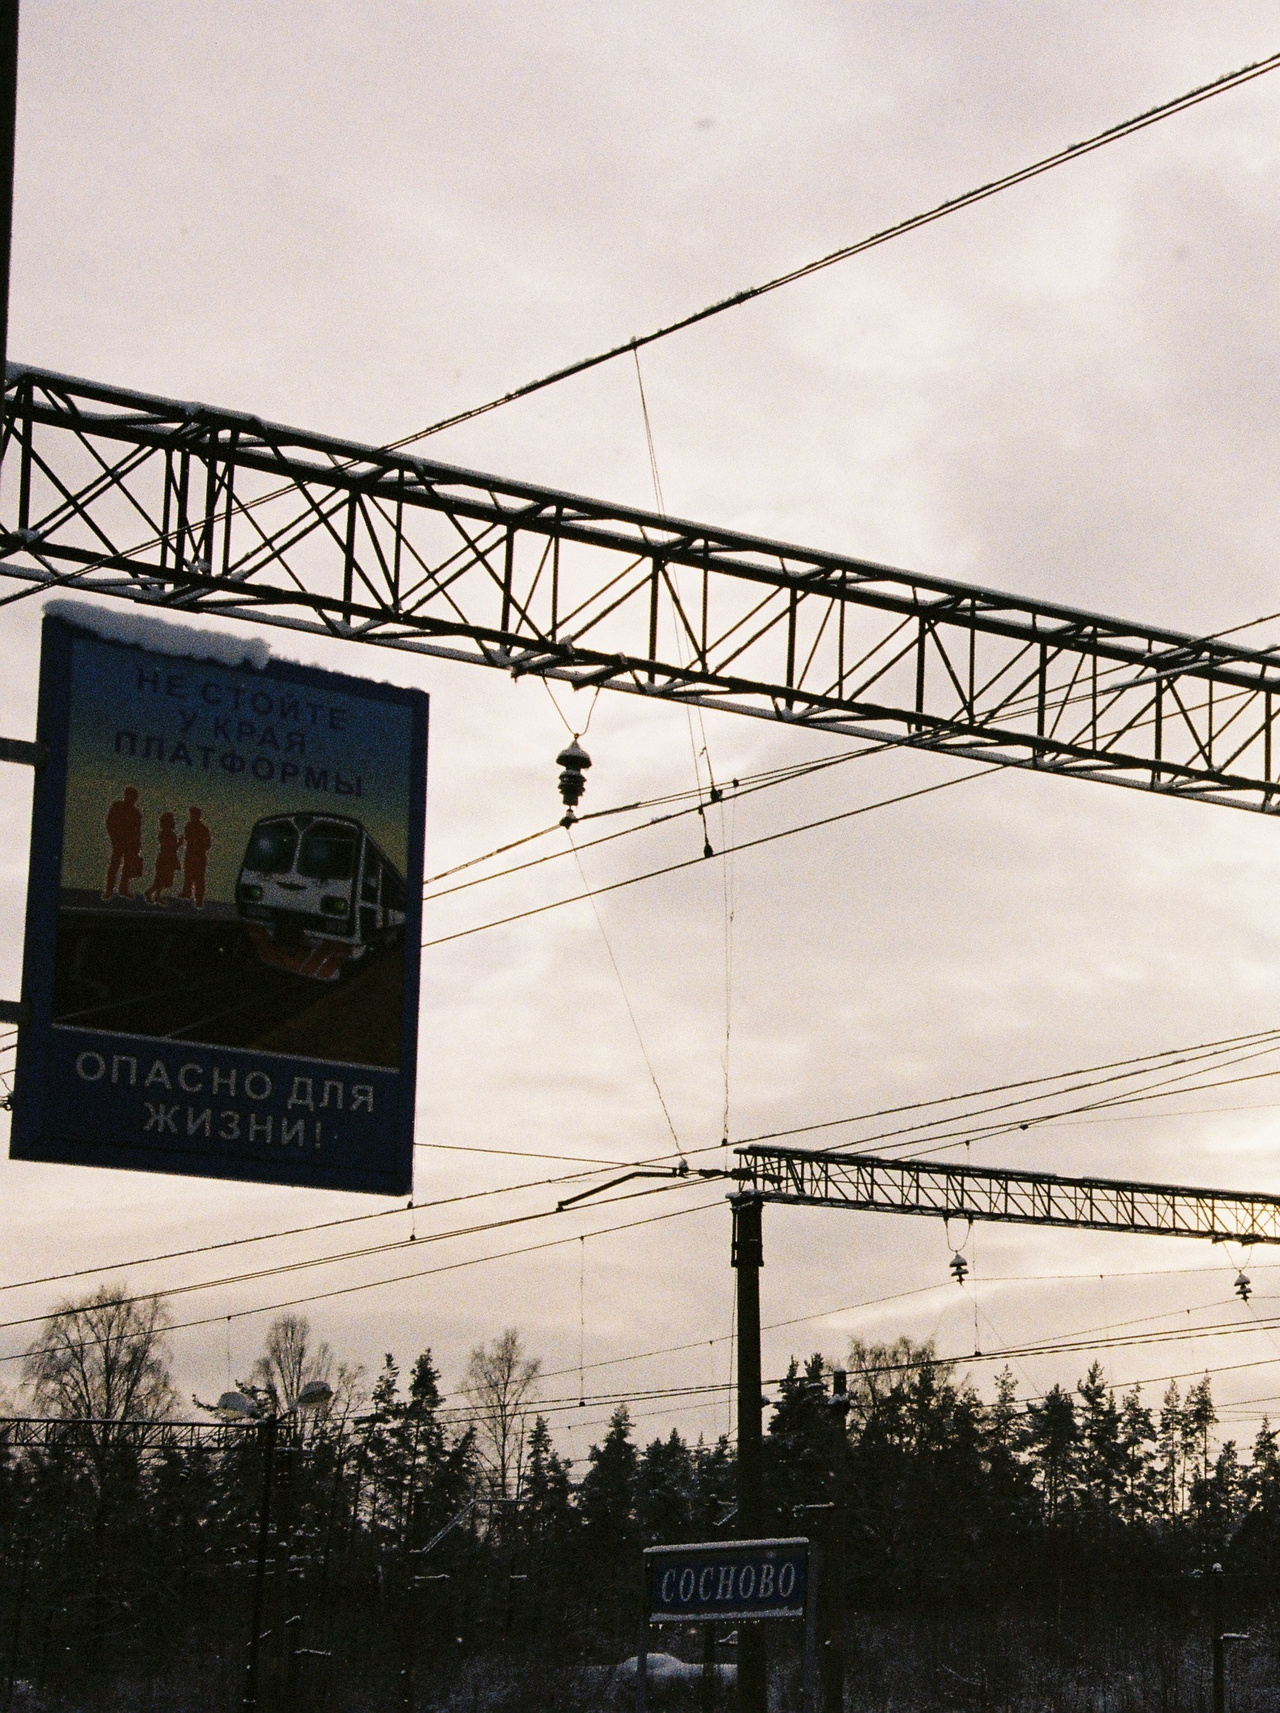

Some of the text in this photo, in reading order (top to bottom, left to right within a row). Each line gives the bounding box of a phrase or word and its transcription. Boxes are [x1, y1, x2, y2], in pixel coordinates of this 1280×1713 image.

[136, 667, 348, 731] НЕ СТОЙТЕ
[179, 709, 306, 755] У КРАЯ
[114, 730, 364, 797] ПЛАТФОРМЫ
[75, 1051, 375, 1113] ОПАСНО ДЛЯ
[142, 1101, 322, 1150] ЖИЗНИ!
[661, 1562, 796, 1602] СОСНОВО
